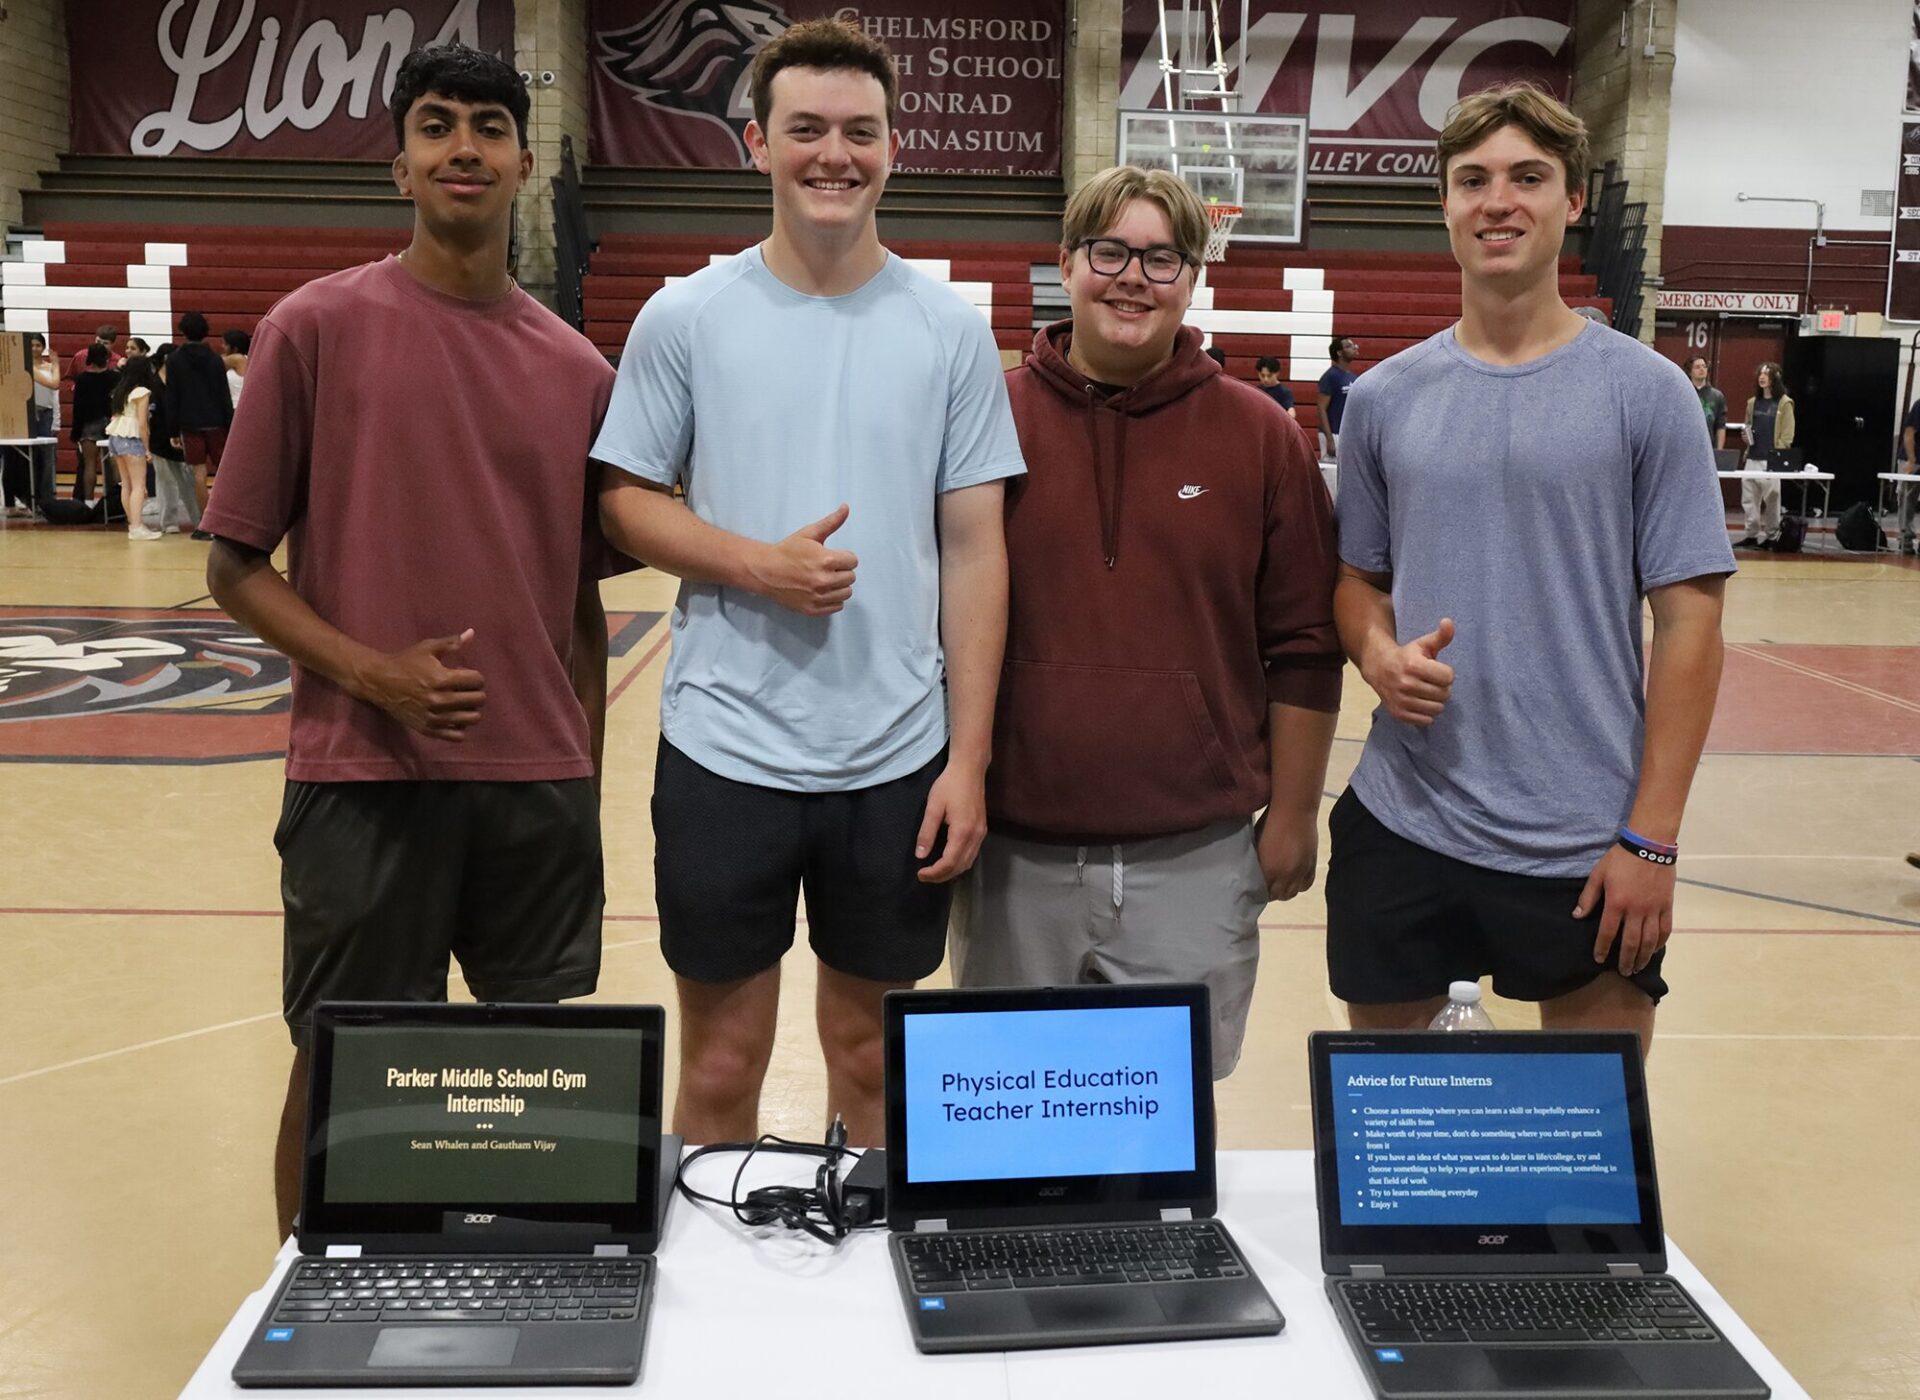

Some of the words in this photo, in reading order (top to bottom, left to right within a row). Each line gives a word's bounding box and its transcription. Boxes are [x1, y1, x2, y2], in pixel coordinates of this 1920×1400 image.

[928, 47, 1061, 79] SCHOOL
[1118, 11, 1572, 134] MVC
[900, 91, 1012, 115] ONRAD
[896, 128, 1043, 153] MNASIUM
[1656, 292, 1745, 309] EMERGENCY
[1752, 295, 1796, 310] ONLY
[1685, 321, 1708, 348] 16
[1182, 484, 1202, 495] NIKE
[386, 1067, 438, 1089] Parker
[441, 1068, 493, 1088] Middle
[497, 1068, 548, 1089] School
[552, 1069, 587, 1090] Gym
[942, 1070, 1036, 1097] Physical
[1044, 1066, 1158, 1089] Education
[1347, 1075, 1388, 1087] Advice
[1390, 1075, 1406, 1087] for
[1409, 1075, 1448, 1087] Future
[1450, 1075, 1493, 1087] Interns
[447, 1093, 525, 1117] Internship
[942, 1100, 1034, 1122] Teacher
[1041, 1095, 1159, 1119] Internship
[1364, 1107, 1389, 1115] Choose
[1400, 1107, 1434, 1117] internship
[1435, 1107, 1456, 1115] where
[1457, 1109, 1470, 1117] you
[1485, 1107, 1502, 1115] learn
[1509, 1107, 1523, 1115] skill
[1533, 1107, 1565, 1117] hopefully
[1567, 1107, 1594, 1115] enhance
[1365, 1118, 1388, 1128] variety
[1390, 1118, 1397, 1126] of
[1398, 1118, 1417, 1126] skills
[1418, 1118, 1435, 1126] from
[1434, 1130, 1451, 1139] time,
[1481, 1130, 1516, 1139] something
[1571, 1130, 1582, 1139] get
[410, 1140, 432, 1150] Sean
[434, 1140, 470, 1150] Whalen
[471, 1140, 488, 1150] and
[490, 1140, 531, 1150] Gautham
[533, 1140, 557, 1152] Vijay
[1366, 1142, 1383, 1150] from
[1384, 1142, 1390, 1150] it
[1536, 1153, 1576, 1162] life/college,
[1577, 1154, 1586, 1162] try
[1393, 1165, 1429, 1174] something
[1438, 1165, 1454, 1174] help
[1469, 1165, 1480, 1174] get
[1529, 1165, 1573, 1174] experiencing
[1574, 1165, 1609, 1174] something
[1368, 1177, 1382, 1185] that
[1384, 1177, 1400, 1185] field
[1401, 1177, 1409, 1185] of
[1410, 1177, 1427, 1185] work
[1038, 1186, 1068, 1197] acer
[1369, 1188, 1382, 1198] Try
[1392, 1188, 1410, 1196] learn
[1410, 1188, 1447, 1198] something
[1448, 1188, 1479, 1198] everyday
[1371, 1200, 1392, 1210] Enjoy
[1393, 1200, 1398, 1208] it
[464, 1212, 498, 1224] acer
[1477, 1234, 1509, 1245] acer
